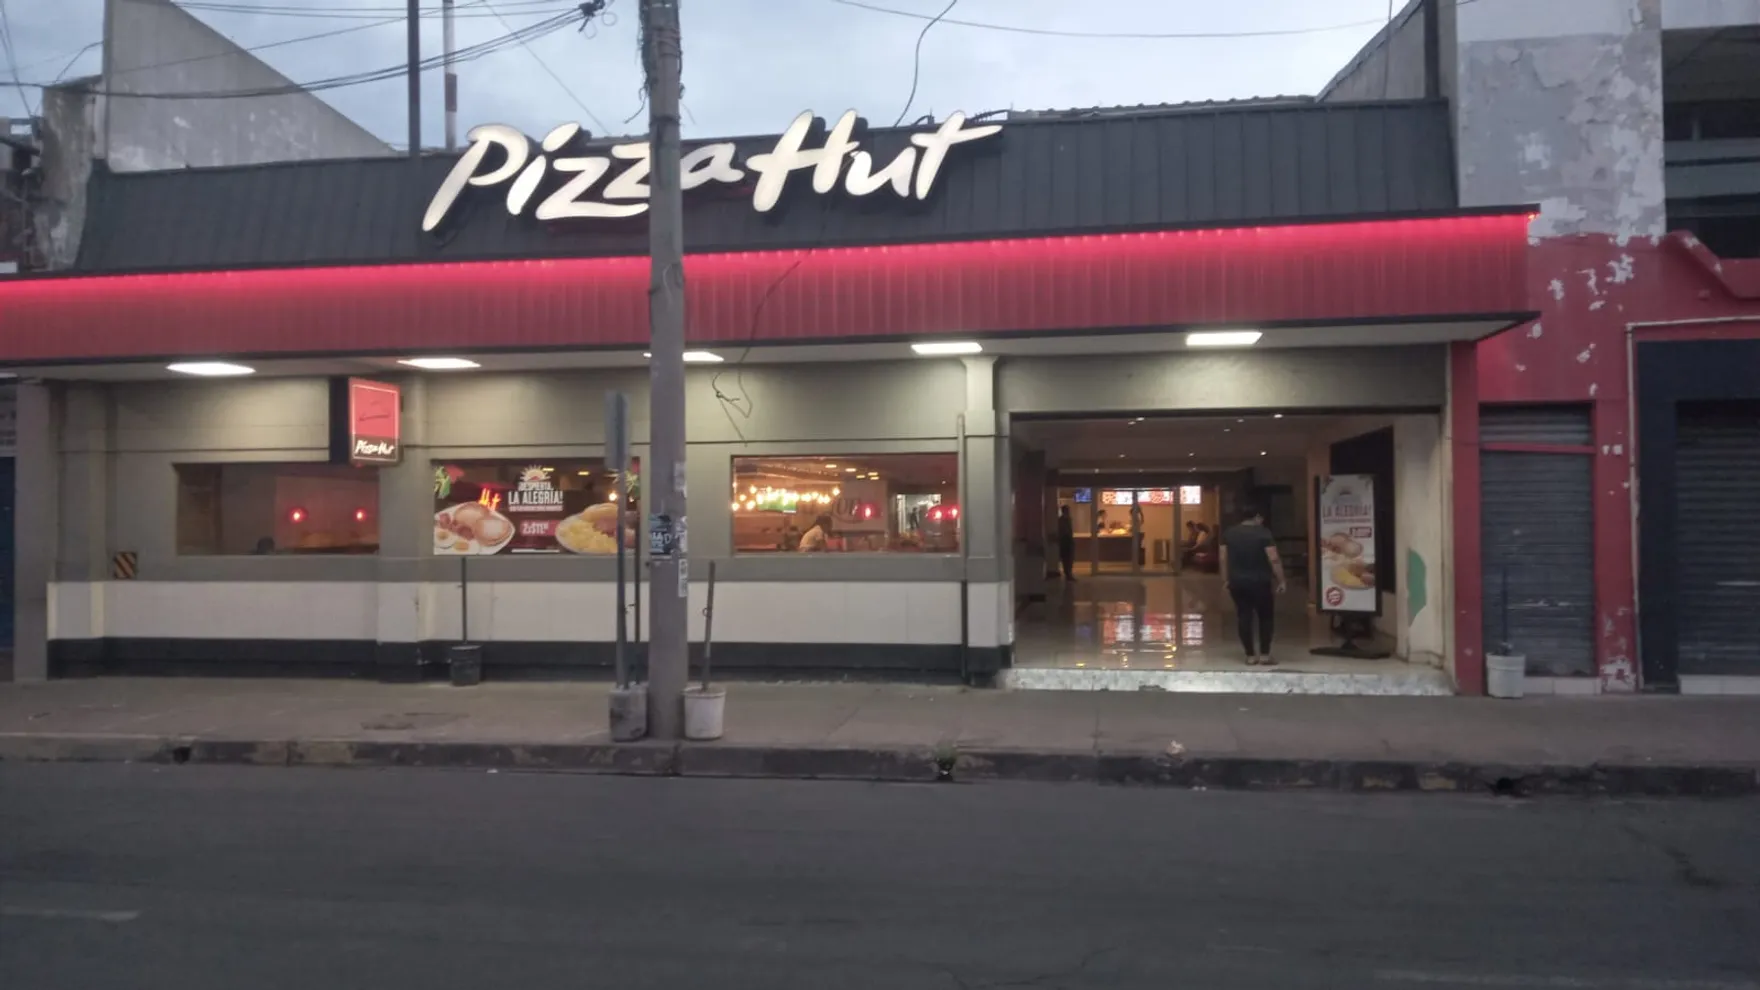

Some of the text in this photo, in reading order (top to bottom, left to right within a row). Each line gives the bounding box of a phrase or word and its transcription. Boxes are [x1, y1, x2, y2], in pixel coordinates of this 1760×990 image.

[422, 109, 1003, 232] Pizza Hut
[508, 491, 520, 505] LA
